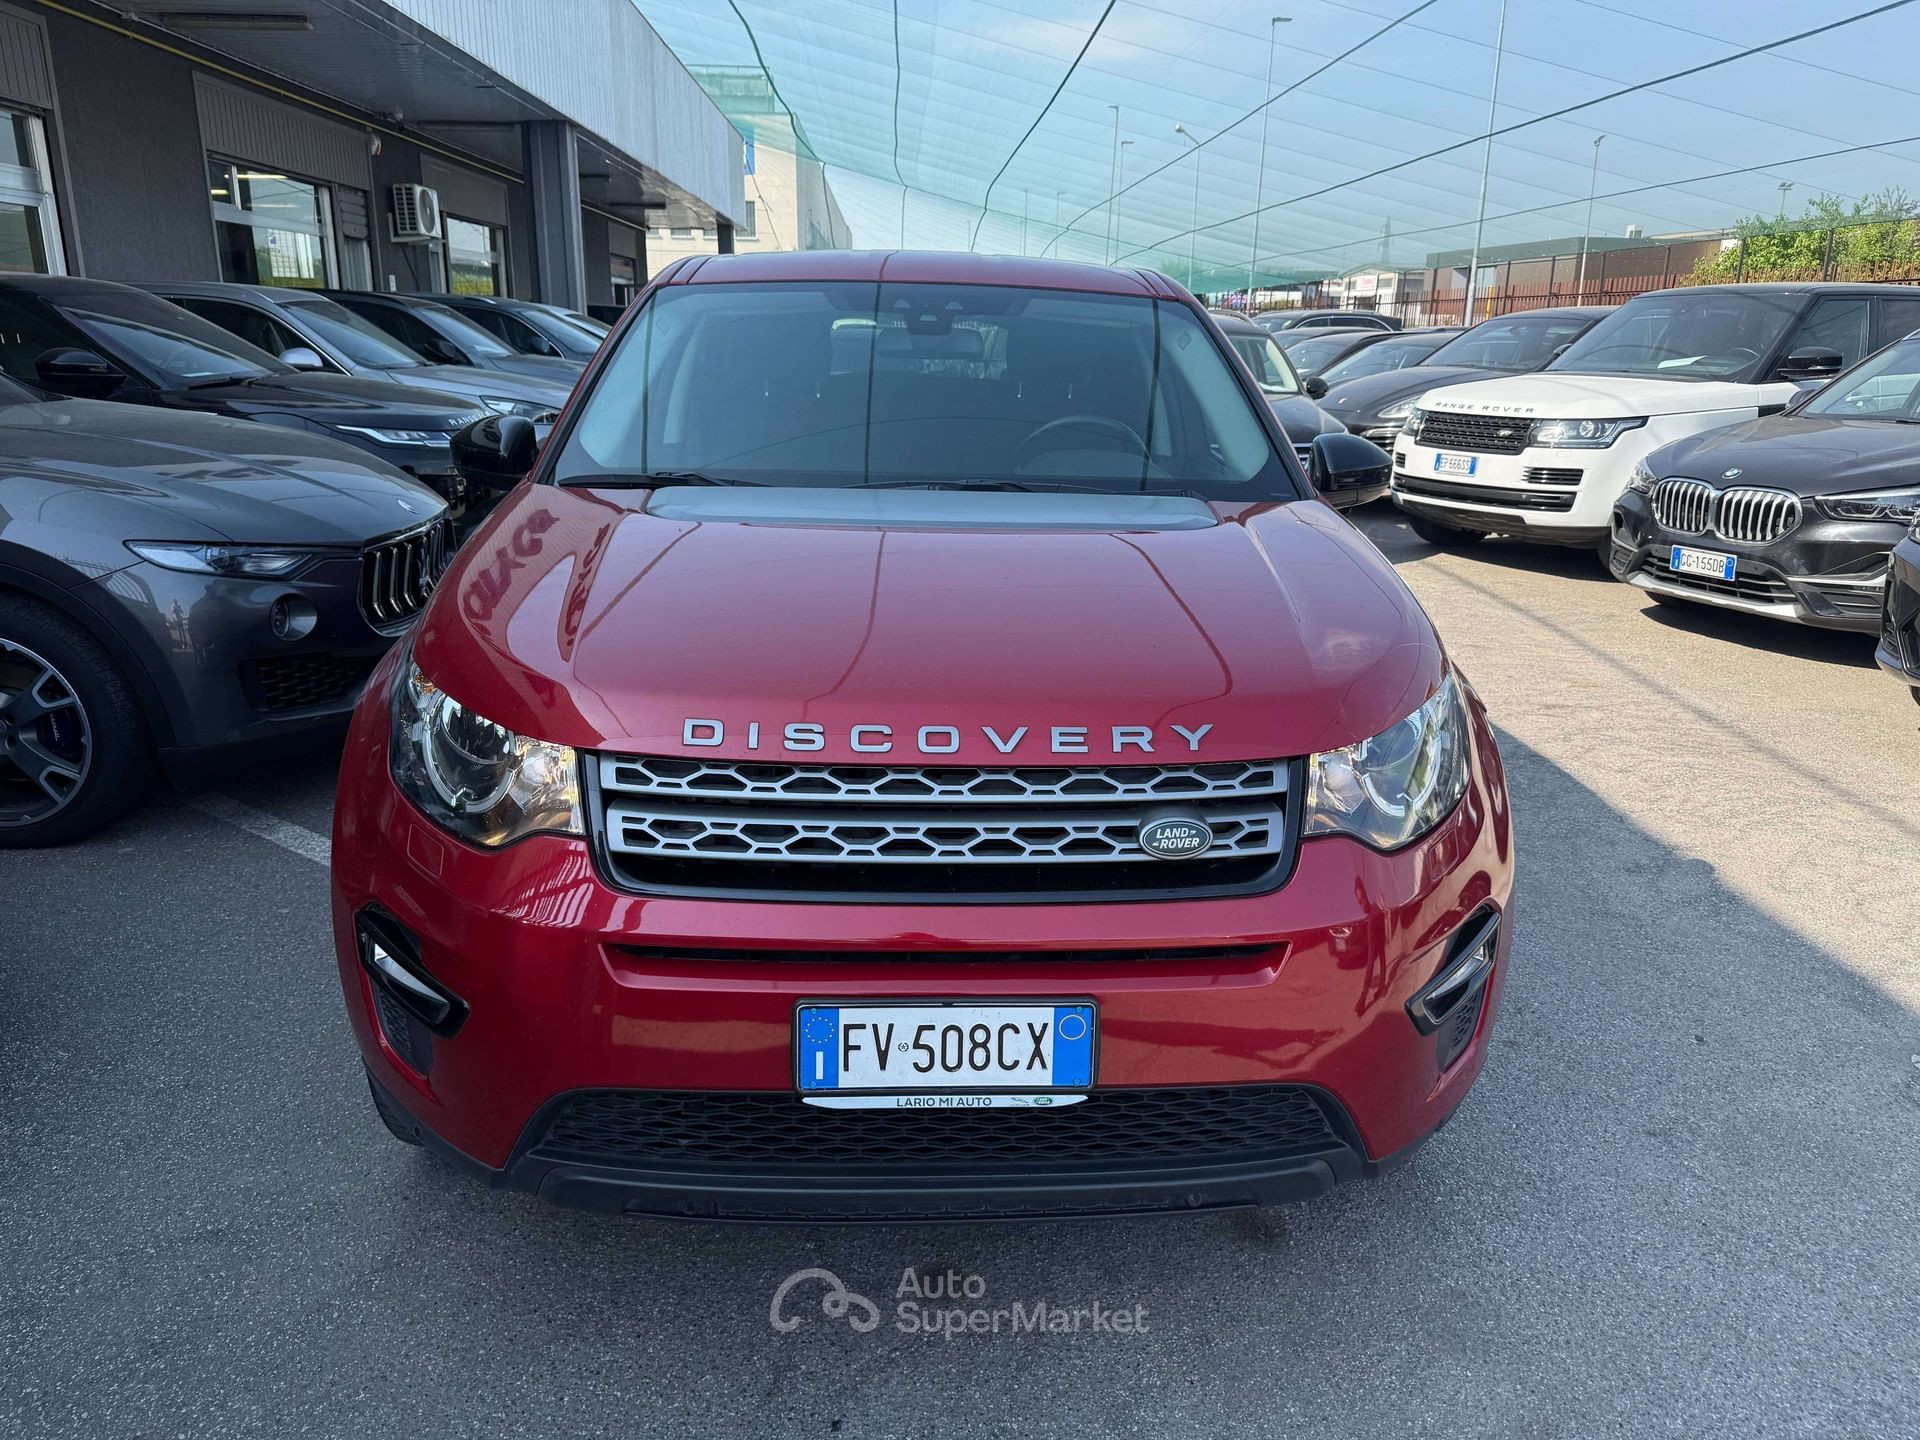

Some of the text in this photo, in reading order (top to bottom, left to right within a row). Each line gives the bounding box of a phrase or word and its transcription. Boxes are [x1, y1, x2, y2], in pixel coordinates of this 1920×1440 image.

[1435, 402, 1534, 413] RANGE ROVER
[683, 718, 1214, 754] DISCOVERY
[1156, 827, 1189, 839] LAND
[1159, 837, 1200, 849] ROVER
[896, 1096, 992, 1107] LARIO MI AUTO
